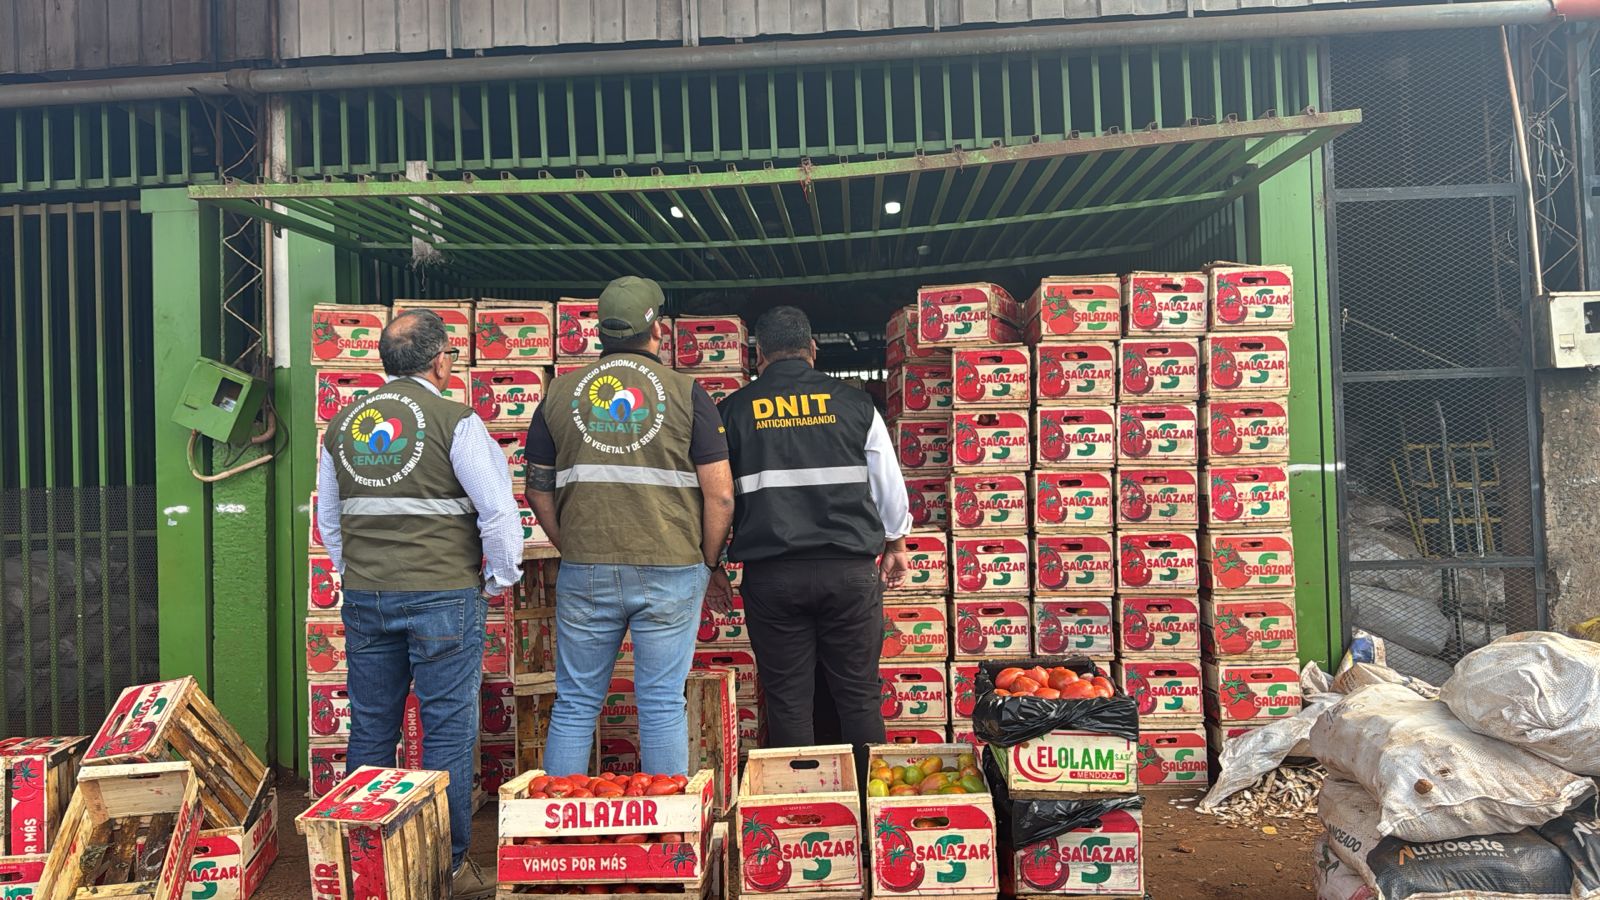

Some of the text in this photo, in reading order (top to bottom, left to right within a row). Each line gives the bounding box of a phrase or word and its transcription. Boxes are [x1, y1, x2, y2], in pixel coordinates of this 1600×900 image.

[1243, 295, 1288, 305] SALAZAR
[1157, 302, 1203, 312] SALAZAR
[944, 312, 987, 323] SALAZAR
[1074, 312, 1119, 322] SALAZAR
[506, 338, 549, 348] SALAZAR
[698, 342, 738, 351] SALAZAR
[1238, 360, 1284, 370] SALAZAR
[1065, 370, 1110, 380] SALAZAR
[1149, 366, 1195, 376] SALAZAR
[574, 359, 666, 401] SERVICIO NACIONAL DE CALIDAD
[981, 374, 1026, 384] SALAZAR
[496, 393, 539, 404] SALAZAR
[366, 392, 400, 404] NACIONAL
[400, 396, 412, 405] DE
[409, 402, 426, 428] CALIDAD
[752, 393, 832, 420] DNIT
[756, 414, 836, 430] ANTICONTRABANDO
[588, 422, 642, 434] SENAVE
[1238, 426, 1284, 436] SALAZAR
[592, 439, 624, 454] VEGETAL
[625, 445, 631, 453] Y
[631, 442, 641, 450] DE
[640, 413, 664, 446] SEMILLAS
[1065, 433, 1111, 444] SALAZAR
[1146, 429, 1193, 440] SALAZAR
[981, 437, 1025, 446] SALAZAR
[352, 454, 402, 466] SENAVE
[354, 474, 386, 487] VEGETAL
[393, 472, 403, 483] DE
[401, 441, 424, 476] SEMILLAS
[1063, 497, 1108, 507] SALAZAR
[1147, 493, 1193, 503] SALAZAR
[979, 500, 1023, 510] SALAZAR
[907, 561, 944, 570] ALAZAR
[982, 563, 1025, 573] SALAZAR
[1063, 561, 1109, 571] SALAZAR
[1147, 558, 1193, 568] SALAZAR
[1246, 565, 1292, 576] SALAZAR
[983, 625, 1027, 635] SALAZAR
[1064, 625, 1109, 635] SALAZAR
[1149, 622, 1195, 632] SALAZAR
[901, 634, 945, 644] SALAZAR
[1247, 630, 1294, 641] SALAZAR
[898, 691, 942, 701] SALAZAR
[1152, 686, 1198, 696] SALAZAR
[1255, 696, 1301, 706] SALAZAR
[602, 705, 638, 716] ALAZAR
[408, 706, 416, 742] VAMOS
[408, 743, 417, 758] POR
[1162, 761, 1207, 772] SALAZAR
[1077, 771, 1118, 779] MENDOZA
[544, 800, 658, 829] SALAZAR
[20, 818, 36, 842] MÁS
[164, 800, 189, 890] SALAZAR
[783, 840, 854, 860] SALAZAR
[916, 844, 989, 861] SALAZAR
[1061, 847, 1136, 863] SALAZAR
[1399, 838, 1505, 865] Nutroeste
[1476, 851, 1509, 859] ANIMAL
[523, 854, 627, 872] VAMOS POR MÁS
[187, 868, 238, 882] ALAZAR
